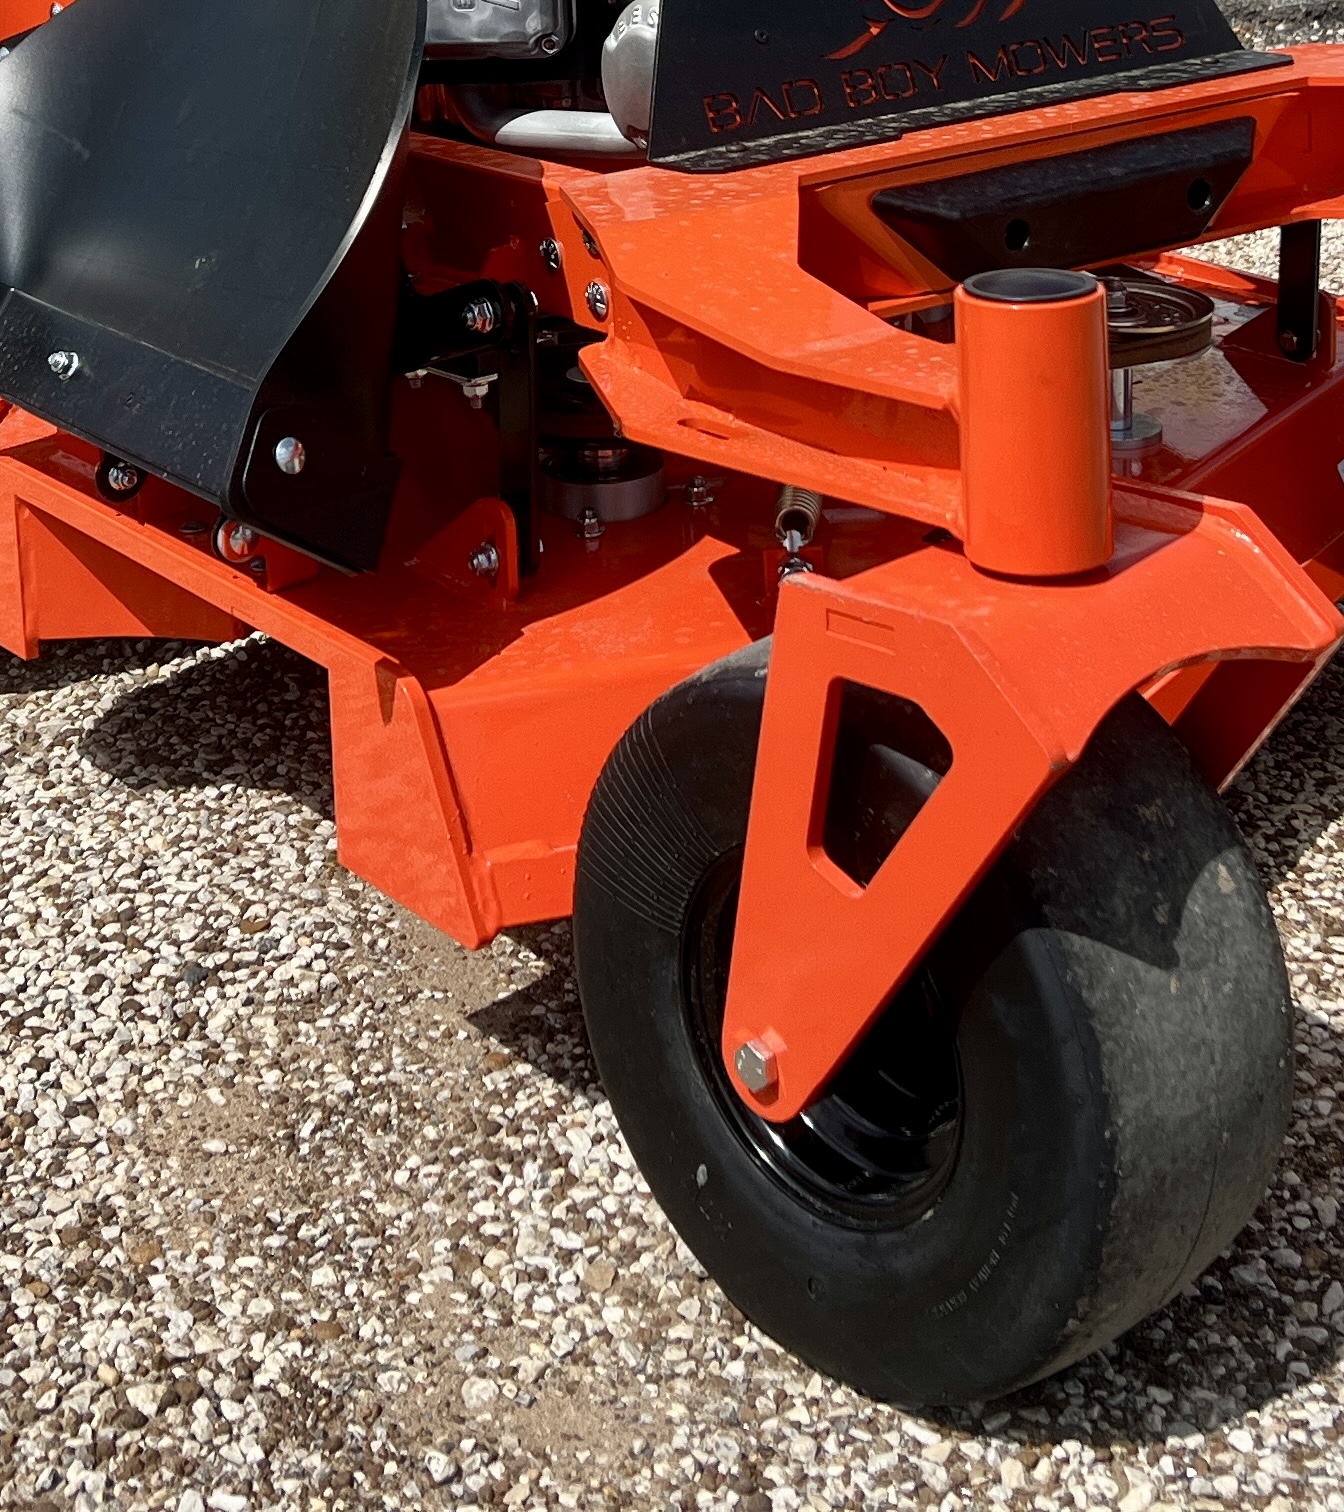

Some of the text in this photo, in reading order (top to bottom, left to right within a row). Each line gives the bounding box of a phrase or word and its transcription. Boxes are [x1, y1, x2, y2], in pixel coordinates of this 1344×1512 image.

[702, 14, 1186, 134] BAD BOY MOWERS
